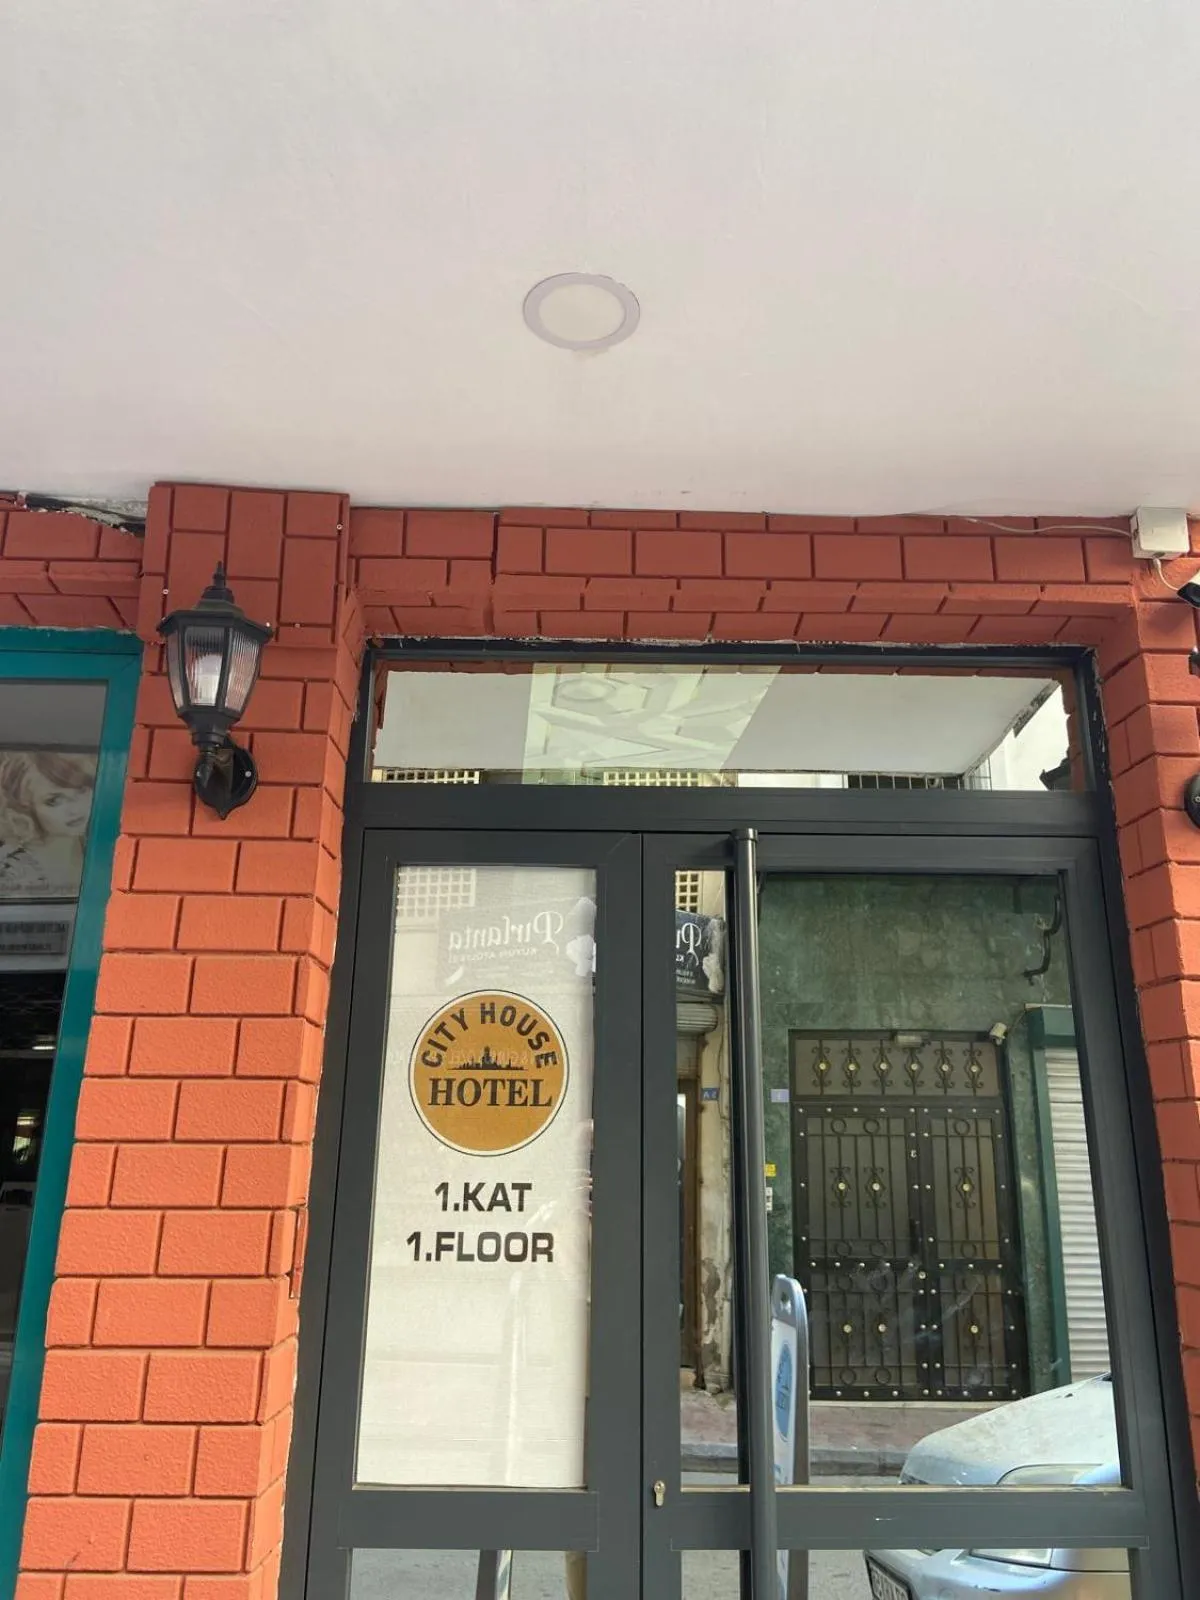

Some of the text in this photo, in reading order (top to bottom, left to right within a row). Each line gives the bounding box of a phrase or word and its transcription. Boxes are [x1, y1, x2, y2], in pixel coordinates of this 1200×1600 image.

[421, 1002, 557, 1068] CITY HOUSE
[427, 1077, 553, 1107] HOTEL
[434, 1182, 533, 1212] 1.KAT
[406, 1231, 554, 1263] 1.FLOOR
